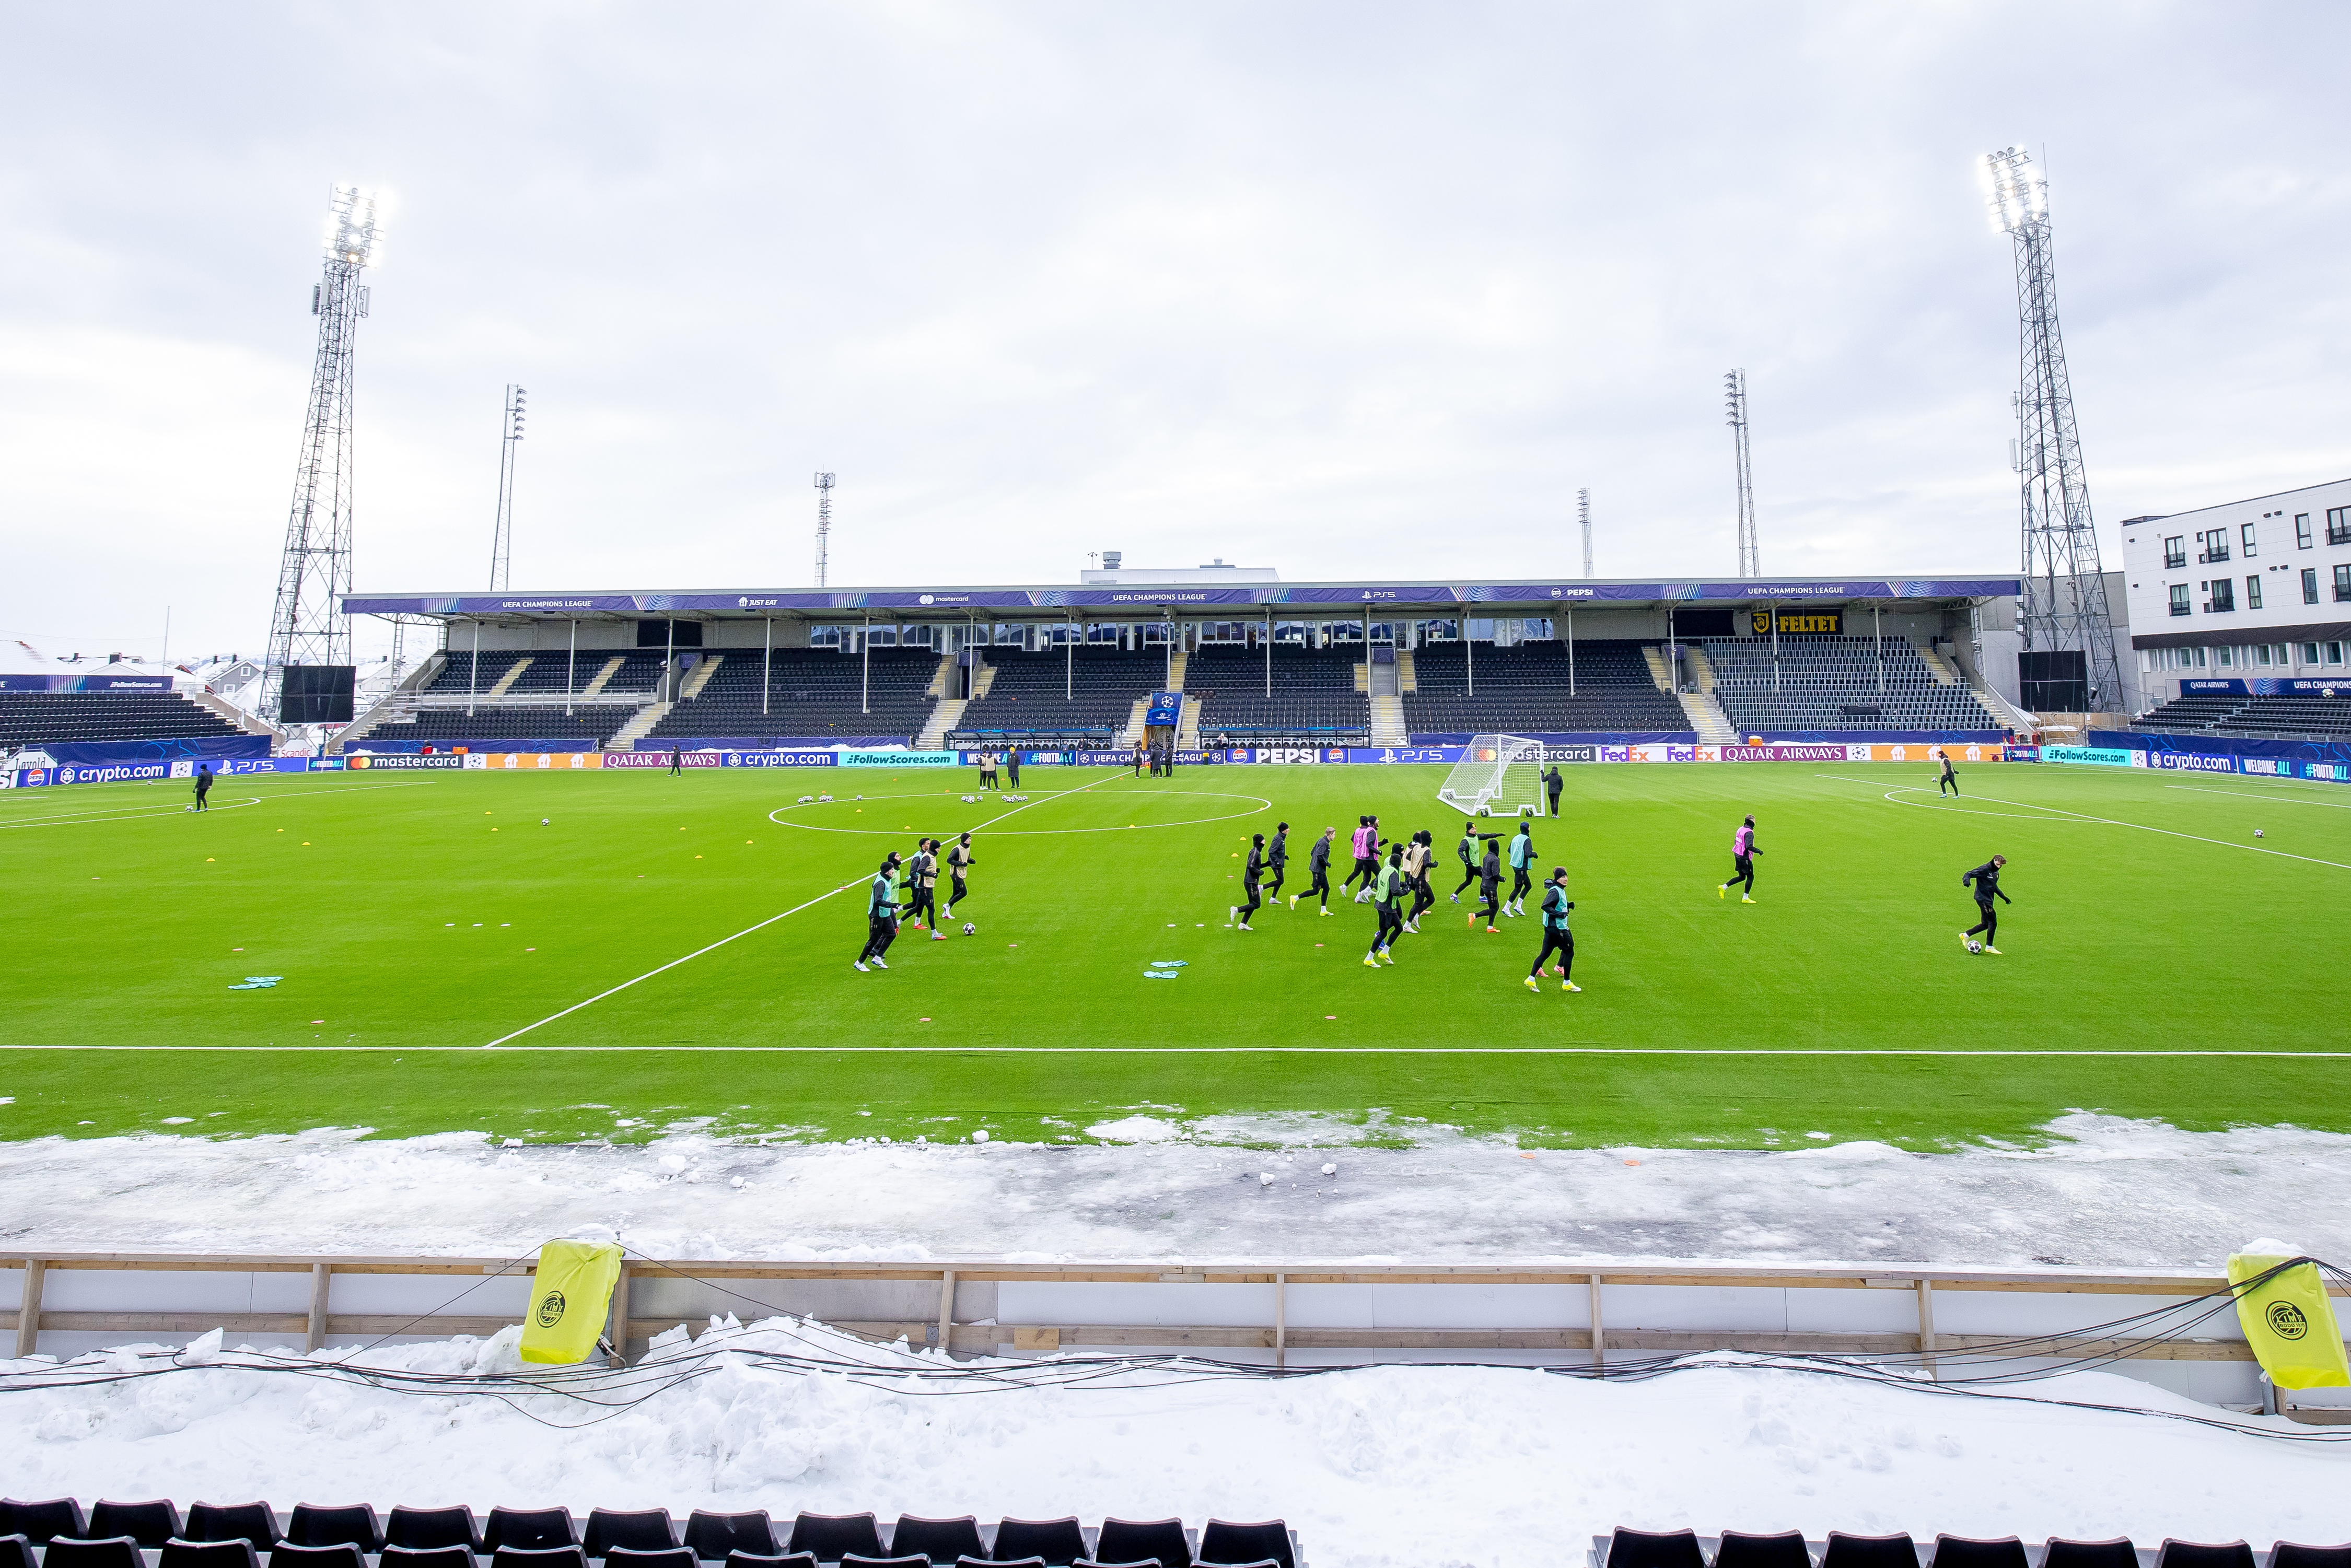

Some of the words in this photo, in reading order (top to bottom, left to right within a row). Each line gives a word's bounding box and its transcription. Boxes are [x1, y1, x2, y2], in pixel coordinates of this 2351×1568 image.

[281, 748, 310, 757] Scandic
[853, 754, 950, 764] FollowScores.com
[1256, 748, 1320, 764] PEPSI
[1401, 750, 1443, 761] PS5
[1601, 747, 1649, 762] FedEx
[1667, 746, 1715, 762] FedEx
[1726, 748, 1775, 760] QATAR
[1780, 747, 1842, 759] AIRWAYS
[2054, 750, 2125, 763] FollowScores.com
[236, 760, 275, 772] PS5
[374, 756, 459, 767] mastercard
[608, 754, 653, 768] QATAR
[658, 754, 716, 765] AIWAYS
[746, 753, 831, 767] crypto.com
[2163, 754, 2231, 770] crypto.com
[2243, 759, 2277, 774] WELCOME
[2277, 761, 2291, 775] ALL
[79, 765, 164, 782] crypto.com
[2306, 763, 2348, 780] #FOOTBALL
